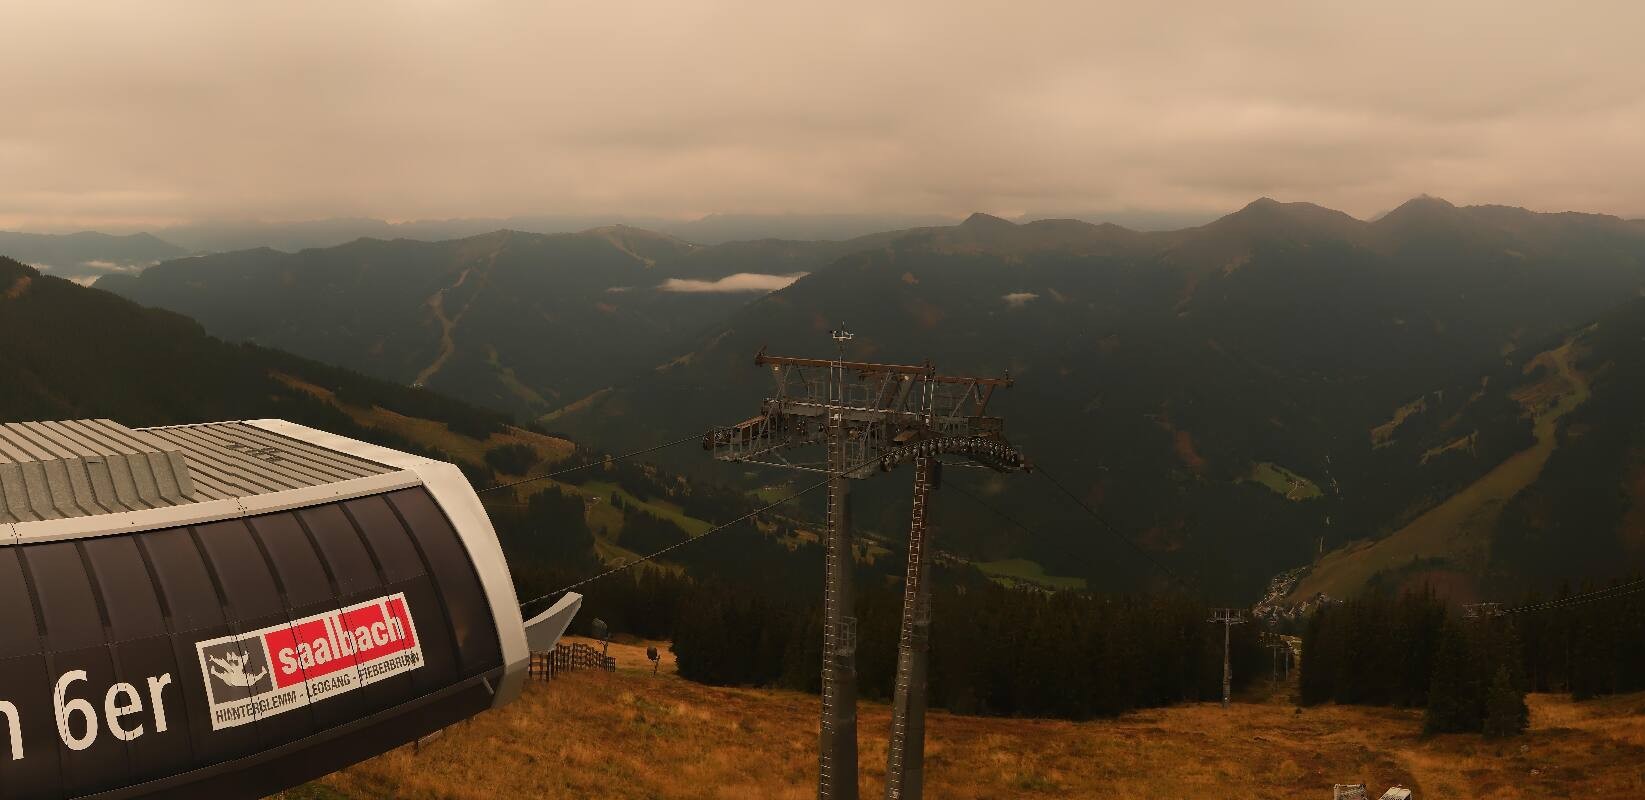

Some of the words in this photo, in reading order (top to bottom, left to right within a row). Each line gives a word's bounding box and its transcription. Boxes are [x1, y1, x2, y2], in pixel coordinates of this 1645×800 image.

[278, 600, 406, 675] saalbach
[53, 669, 172, 751] 6er
[215, 690, 298, 724] HINTERGLEMM
[306, 673, 351, 699] LEOGANG
[358, 651, 421, 681] FIEBERBRUNN
